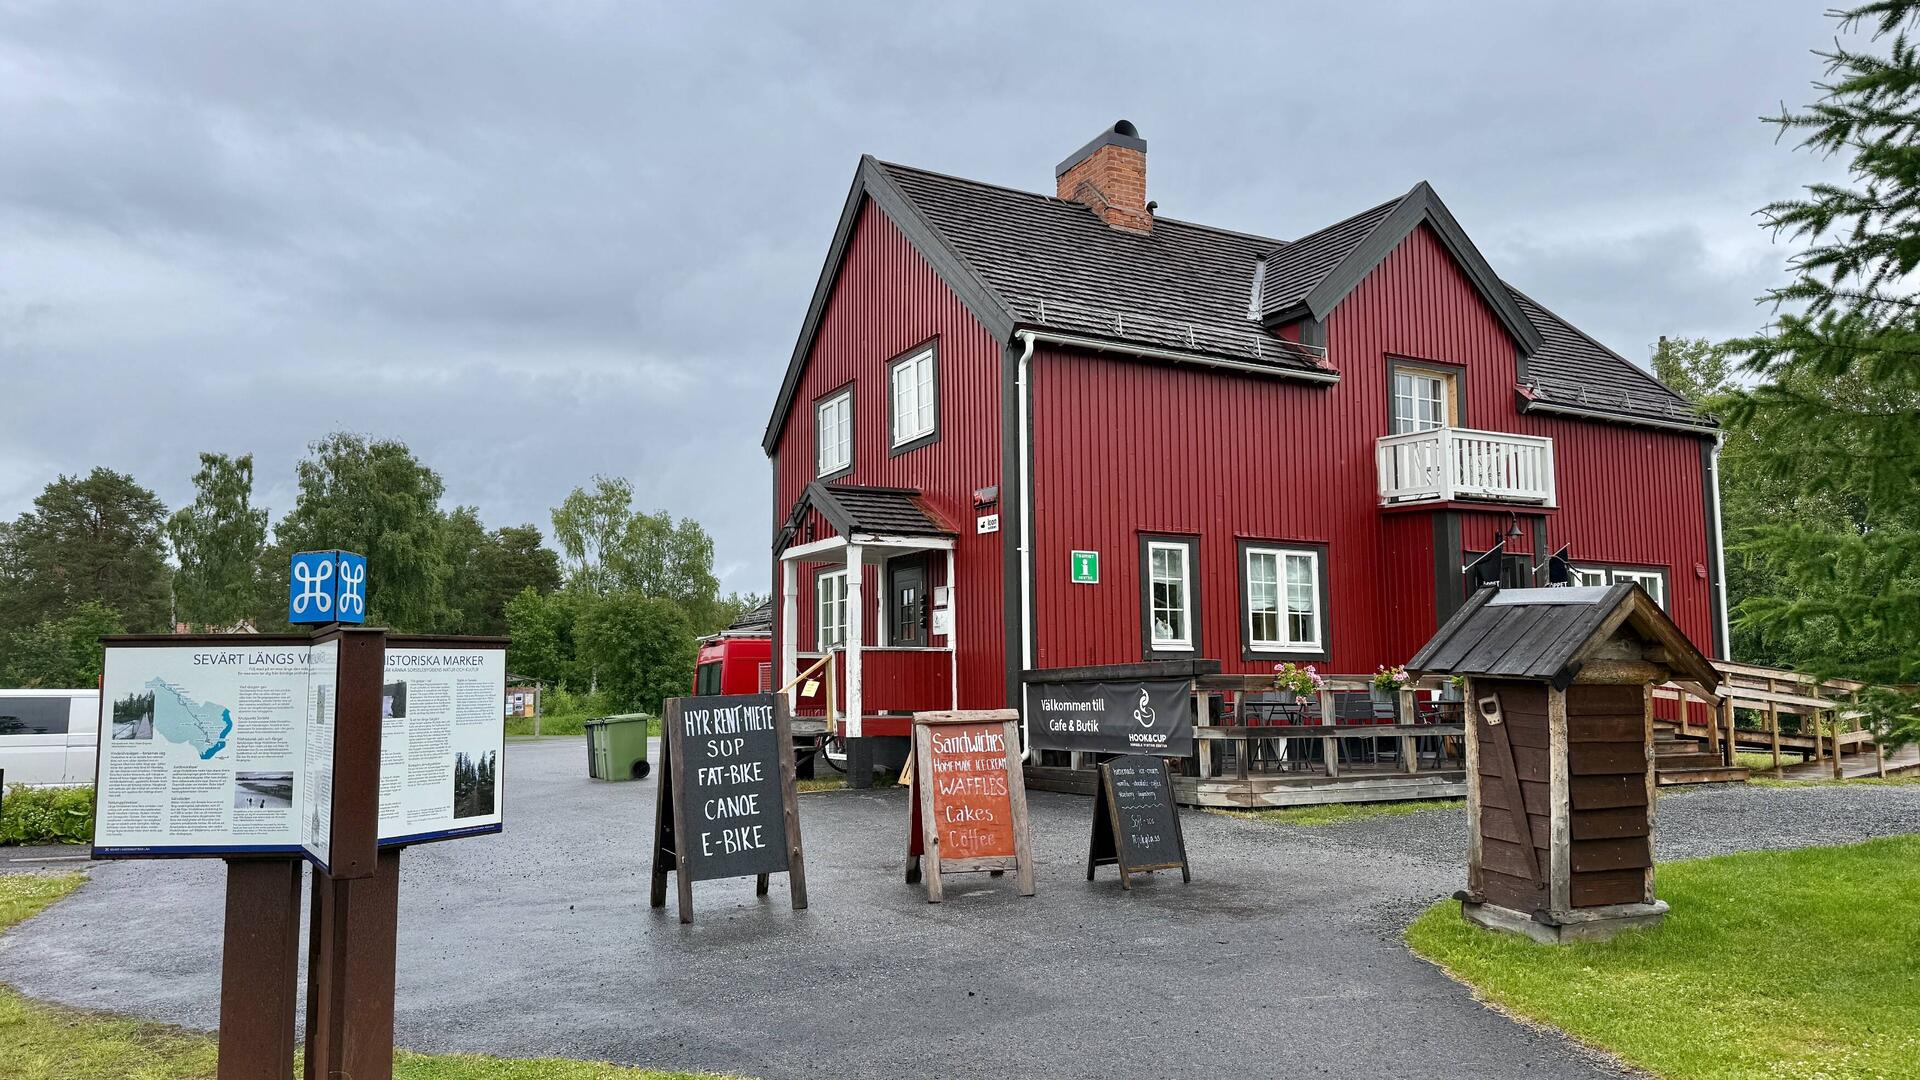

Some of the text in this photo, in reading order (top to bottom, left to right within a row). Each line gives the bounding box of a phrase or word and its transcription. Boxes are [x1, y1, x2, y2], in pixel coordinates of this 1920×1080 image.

[193, 652, 310, 665] SEVÄRT LÄNGS VI
[443, 655, 483, 666] MARKER
[1040, 698, 1105, 712] Välkommen till
[1049, 719, 1099, 733] Cafe & Butik
[932, 729, 1005, 754] Sandwiches
[1128, 733, 1166, 743] HOOK&CUP
[706, 738, 744, 758] SUP
[697, 761, 764, 786] FAT-BIKE
[939, 777, 1008, 796] WAFFLES
[704, 793, 761, 821] CANOE
[945, 805, 994, 823] Cakes
[701, 825, 766, 857] E-BIKE
[949, 828, 996, 850] Coffee
